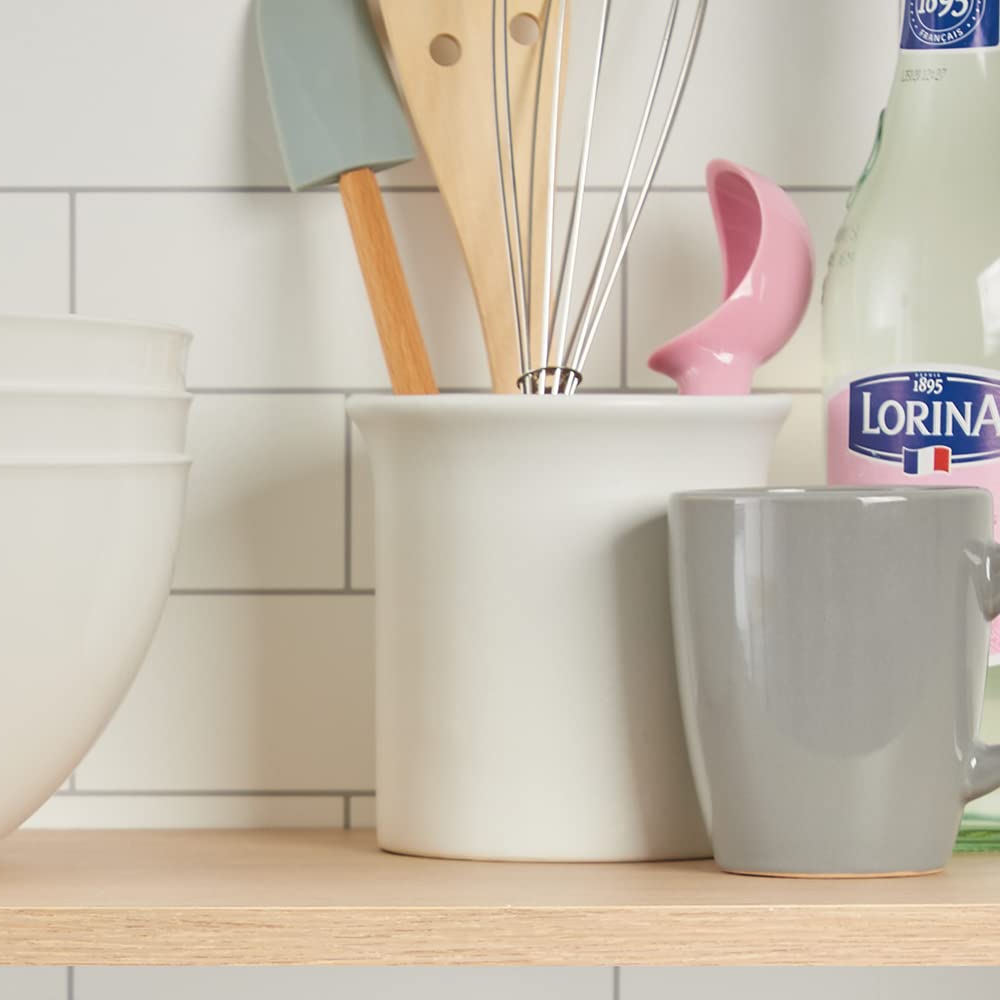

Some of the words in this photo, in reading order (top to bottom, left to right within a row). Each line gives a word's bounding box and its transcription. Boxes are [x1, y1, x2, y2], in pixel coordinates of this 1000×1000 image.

[918, 28, 964, 43] FRANÇAIS
[913, 376, 943, 395] 1895
[862, 391, 1000, 437] LORINA
